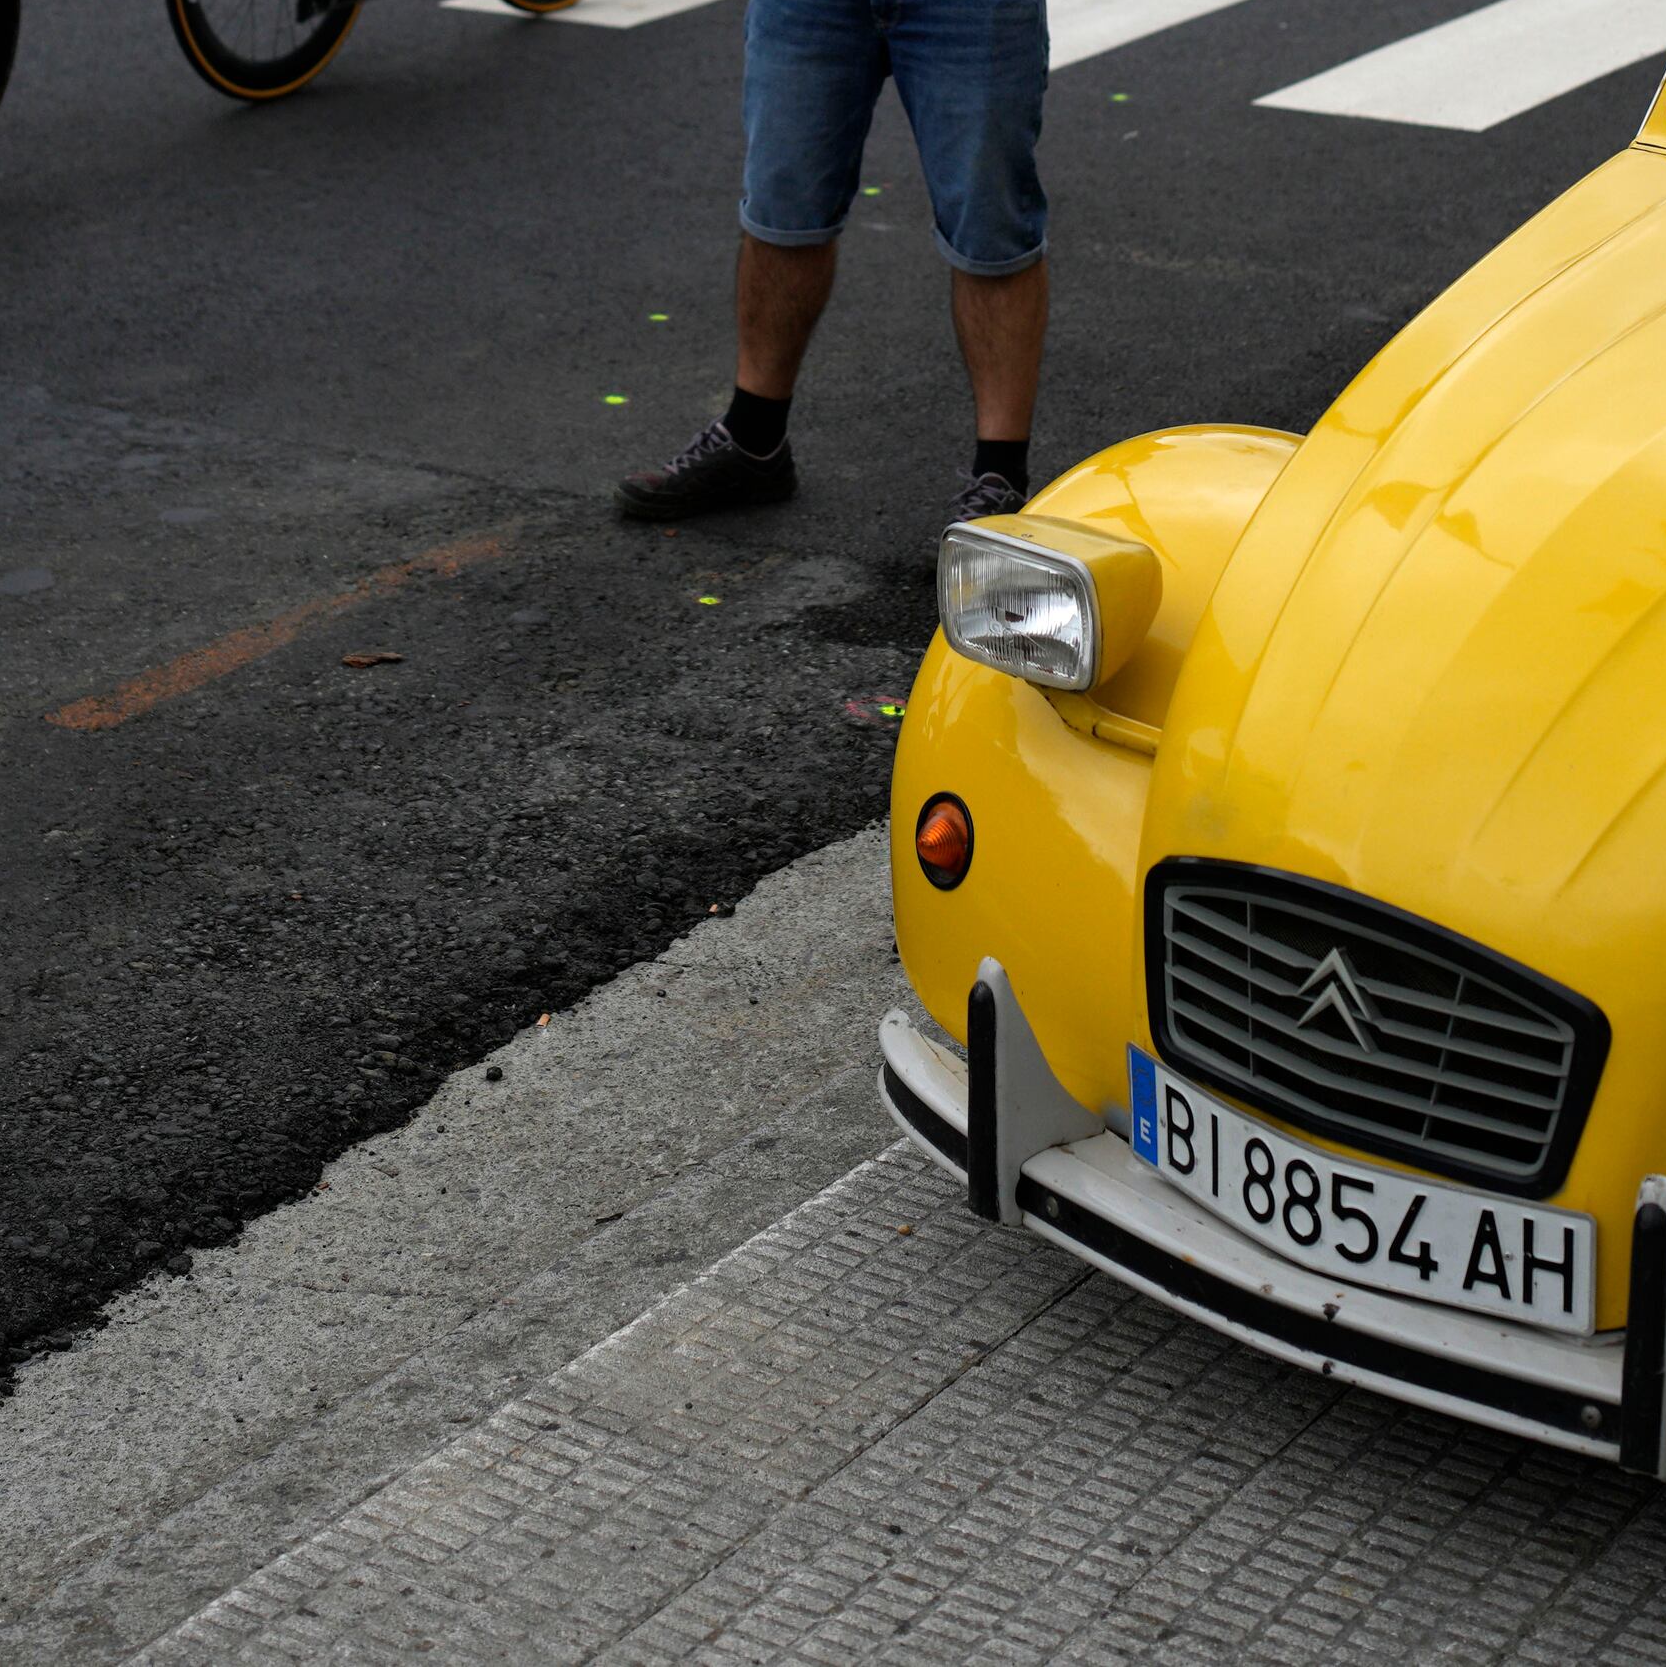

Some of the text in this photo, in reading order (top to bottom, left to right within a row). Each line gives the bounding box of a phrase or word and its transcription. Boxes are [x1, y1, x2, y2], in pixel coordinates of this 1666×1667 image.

[1139, 1115, 1152, 1145] E
[1165, 1084, 1574, 1314] BI 8854 AH
